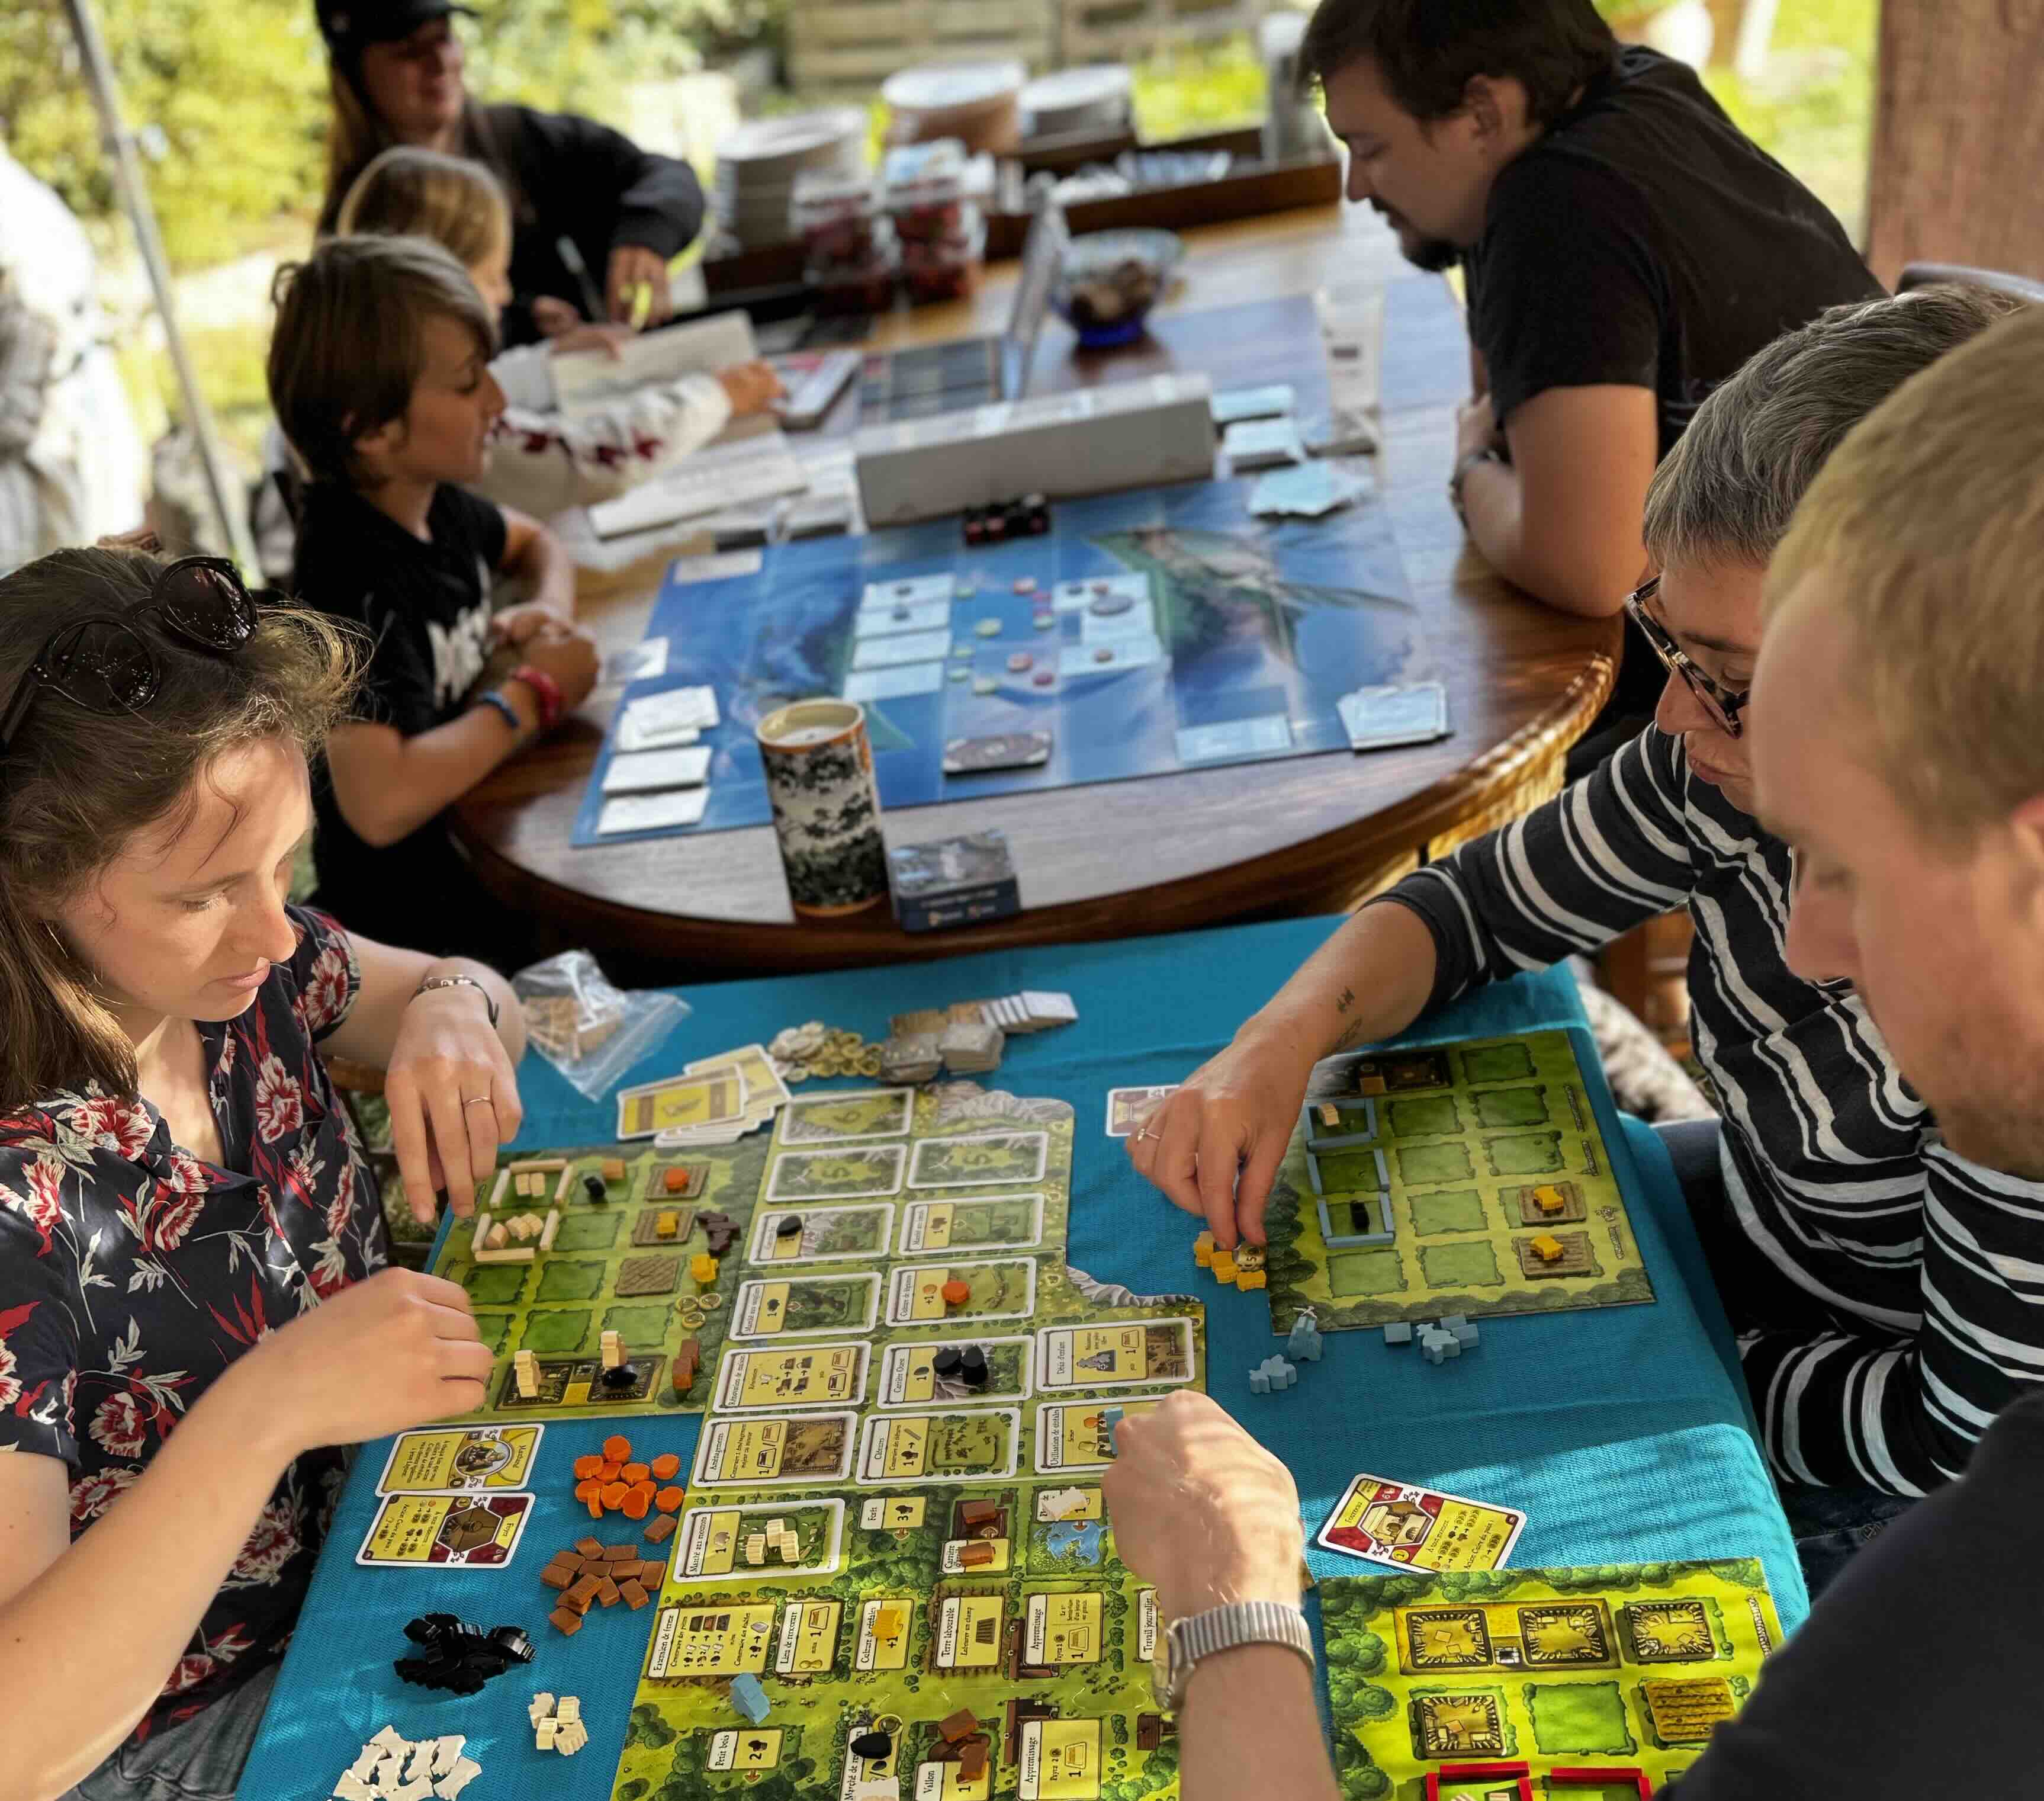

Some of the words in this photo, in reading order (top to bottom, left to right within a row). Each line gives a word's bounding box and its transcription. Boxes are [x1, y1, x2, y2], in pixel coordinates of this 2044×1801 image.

[689, 1552, 700, 1572] Marché
[944, 1544, 955, 1568] Carrière
[944, 1607, 955, 1639] labourable
[1144, 1598, 1155, 1627] journalier
[1030, 1608, 1043, 1649] Apprentissage
[885, 1636, 898, 1649] +1
[941, 1640, 952, 1658] Terre
[1143, 1629, 1152, 1652] Travail
[718, 1734, 729, 1749] bois
[715, 1751, 727, 1767] Petit
[848, 1765, 858, 1774] de
[1024, 1736, 1037, 1783] Apprentissage
[844, 1775, 856, 1801] Marché
[923, 1770, 935, 1794] Vallon
